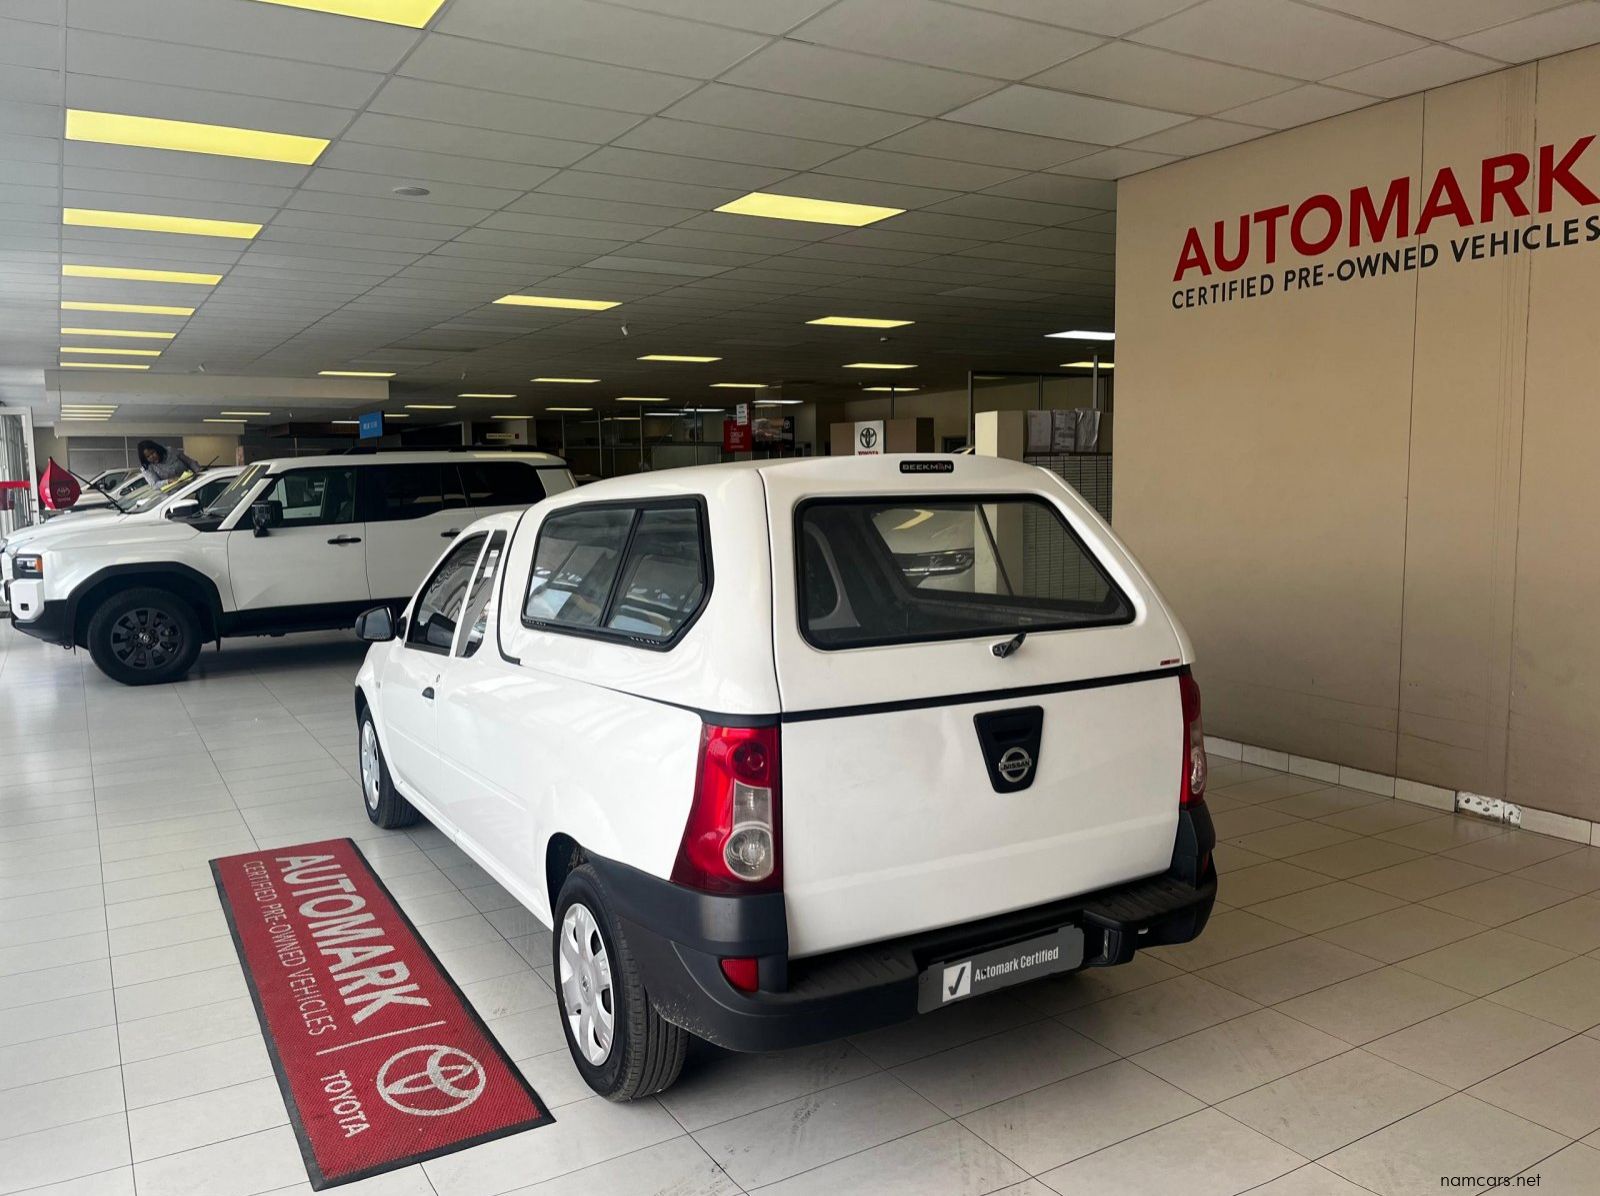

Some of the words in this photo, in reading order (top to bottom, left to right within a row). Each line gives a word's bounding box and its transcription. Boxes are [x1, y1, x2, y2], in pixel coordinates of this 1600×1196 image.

[1173, 134, 1600, 282] AUTOMARK
[1171, 273, 1275, 310] CERTIFIED
[1283, 242, 1439, 292] PRE-OWNED
[1450, 214, 1600, 263] VEHICLES
[902, 463, 952, 471] BEEKMAN
[1002, 760, 1030, 770] NISSAN
[243, 860, 278, 902] CERTIFIED
[261, 902, 307, 968] PRE-OWNED
[288, 967, 337, 1036] VEHICLES
[275, 854, 432, 1026] AUTOMARK
[974, 957, 1020, 983] Automark
[1020, 946, 1059, 969] Certified
[320, 1069, 371, 1138] TOYOTA
